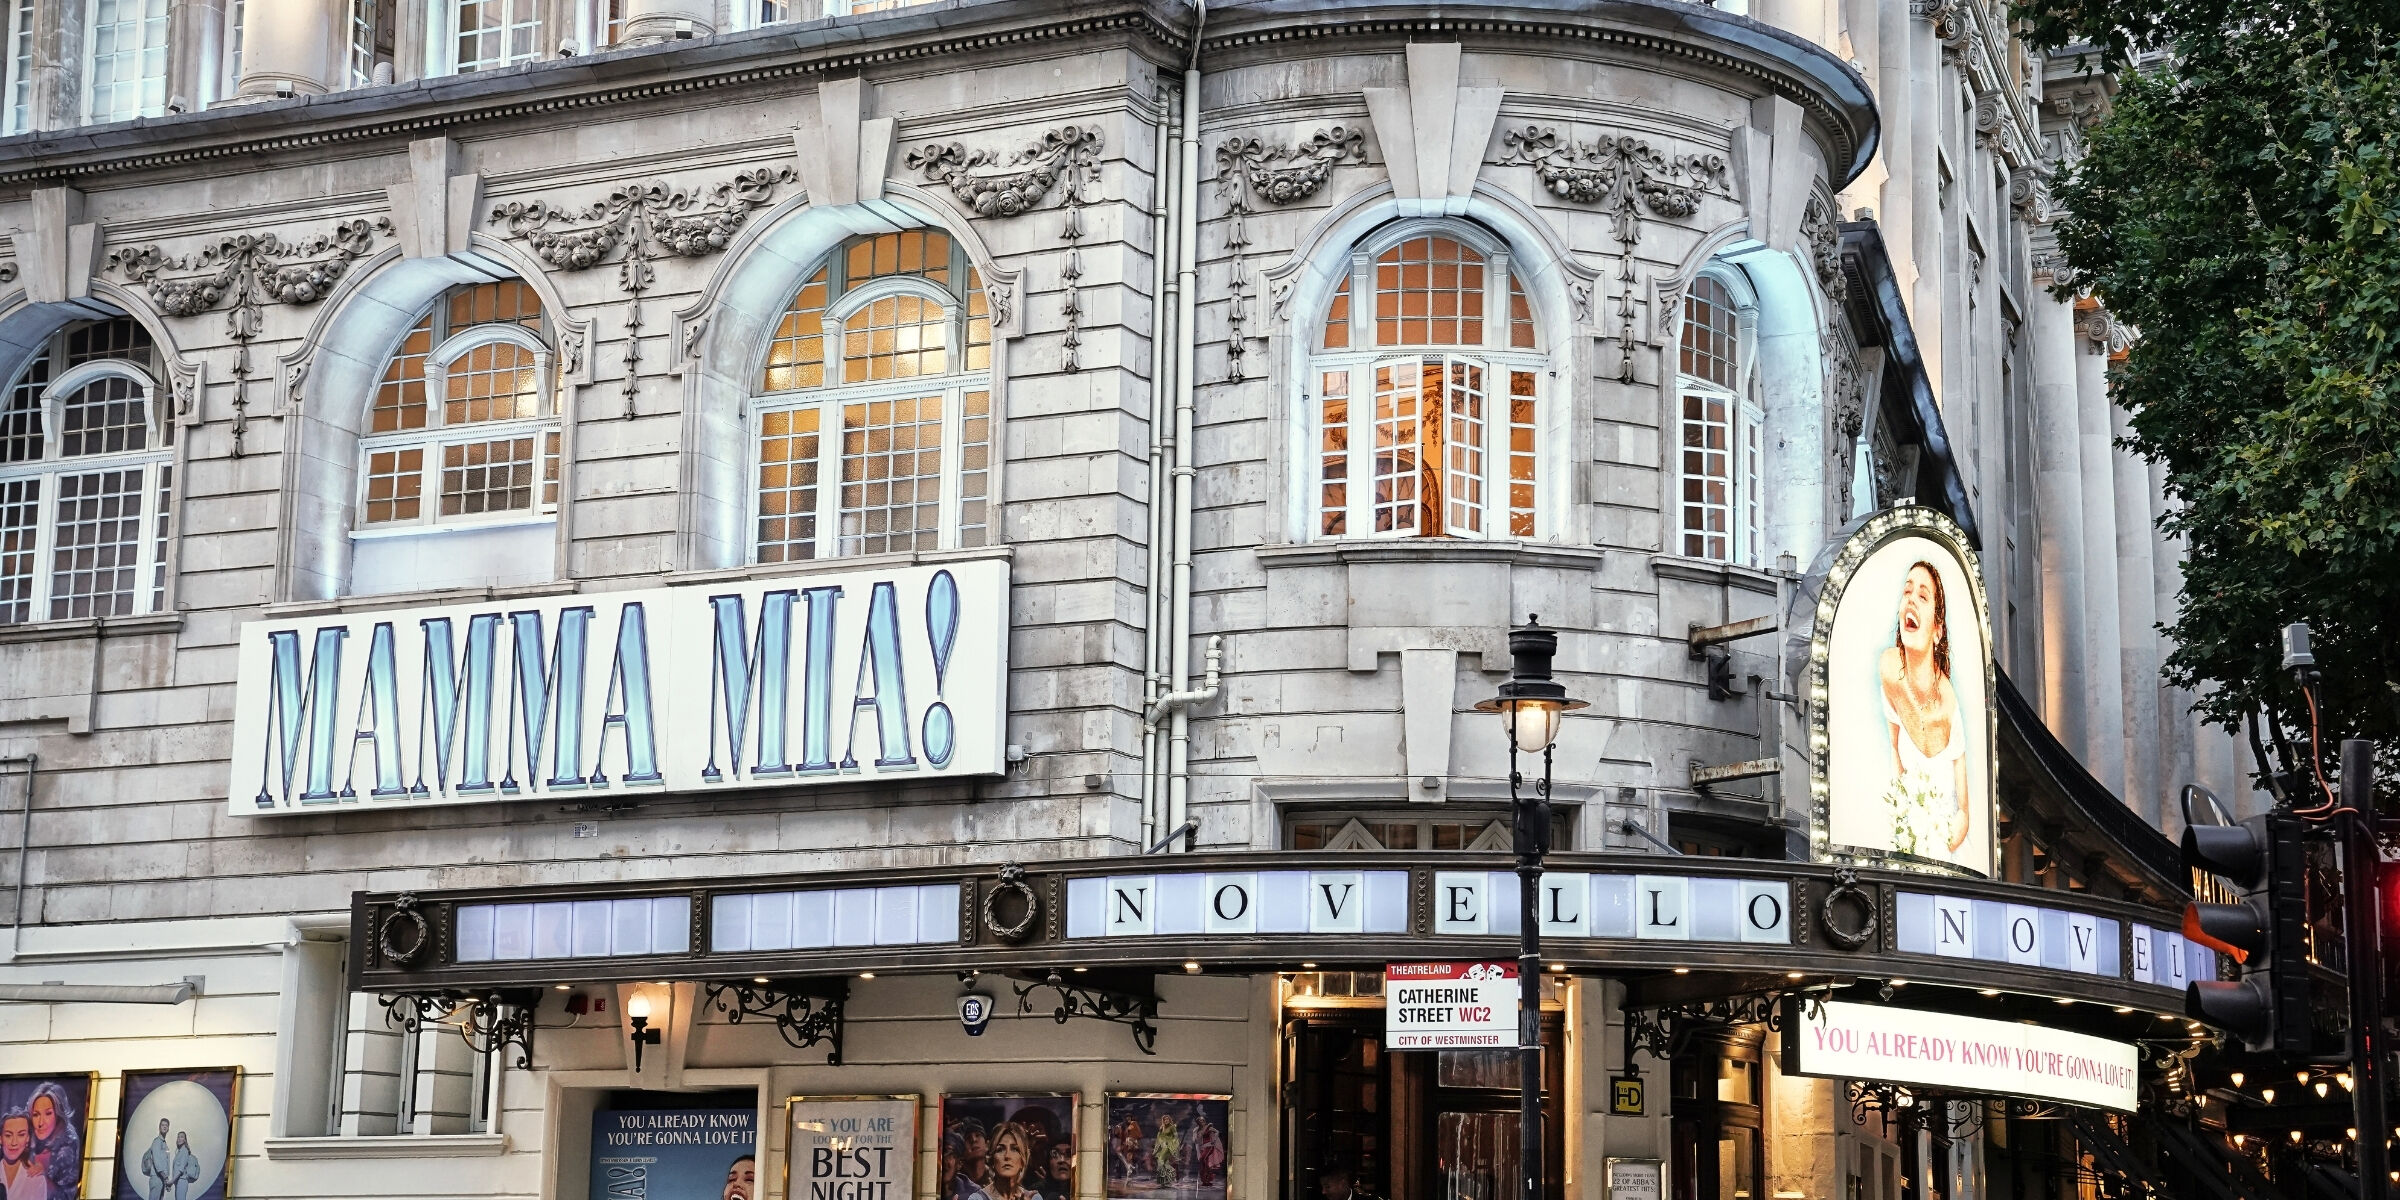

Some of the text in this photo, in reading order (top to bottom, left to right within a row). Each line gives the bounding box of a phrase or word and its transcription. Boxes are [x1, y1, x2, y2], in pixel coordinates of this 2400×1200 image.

[255, 569, 961, 807] MAMMA MIA!
[1114, 883, 1782, 930] NOVELLO
[1391, 964, 1451, 975] THEATRELAND
[1398, 988, 1479, 1004] CATHERINE
[966, 1003, 979, 1016] ECS
[1398, 1007, 1491, 1023] STREET WC2
[1398, 1035, 1499, 1045] CITY OF WESTMINSTER
[1814, 1026, 2134, 1091] YOU ALREADY KNOW YOU'RE GONNA LOVE IT!
[619, 1114, 750, 1129] YOU ALREADY KNOW
[831, 1117, 862, 1132] YOU
[867, 1117, 895, 1132] ARE
[607, 1130, 755, 1146] YOU'RE GONNA LOVE IT
[855, 1134, 873, 1144] FOR
[876, 1134, 892, 1144] THE
[812, 1146, 894, 1178] BEST
[811, 1181, 892, 1200] NIGHT
[1527, 1177, 1533, 1190] 1
